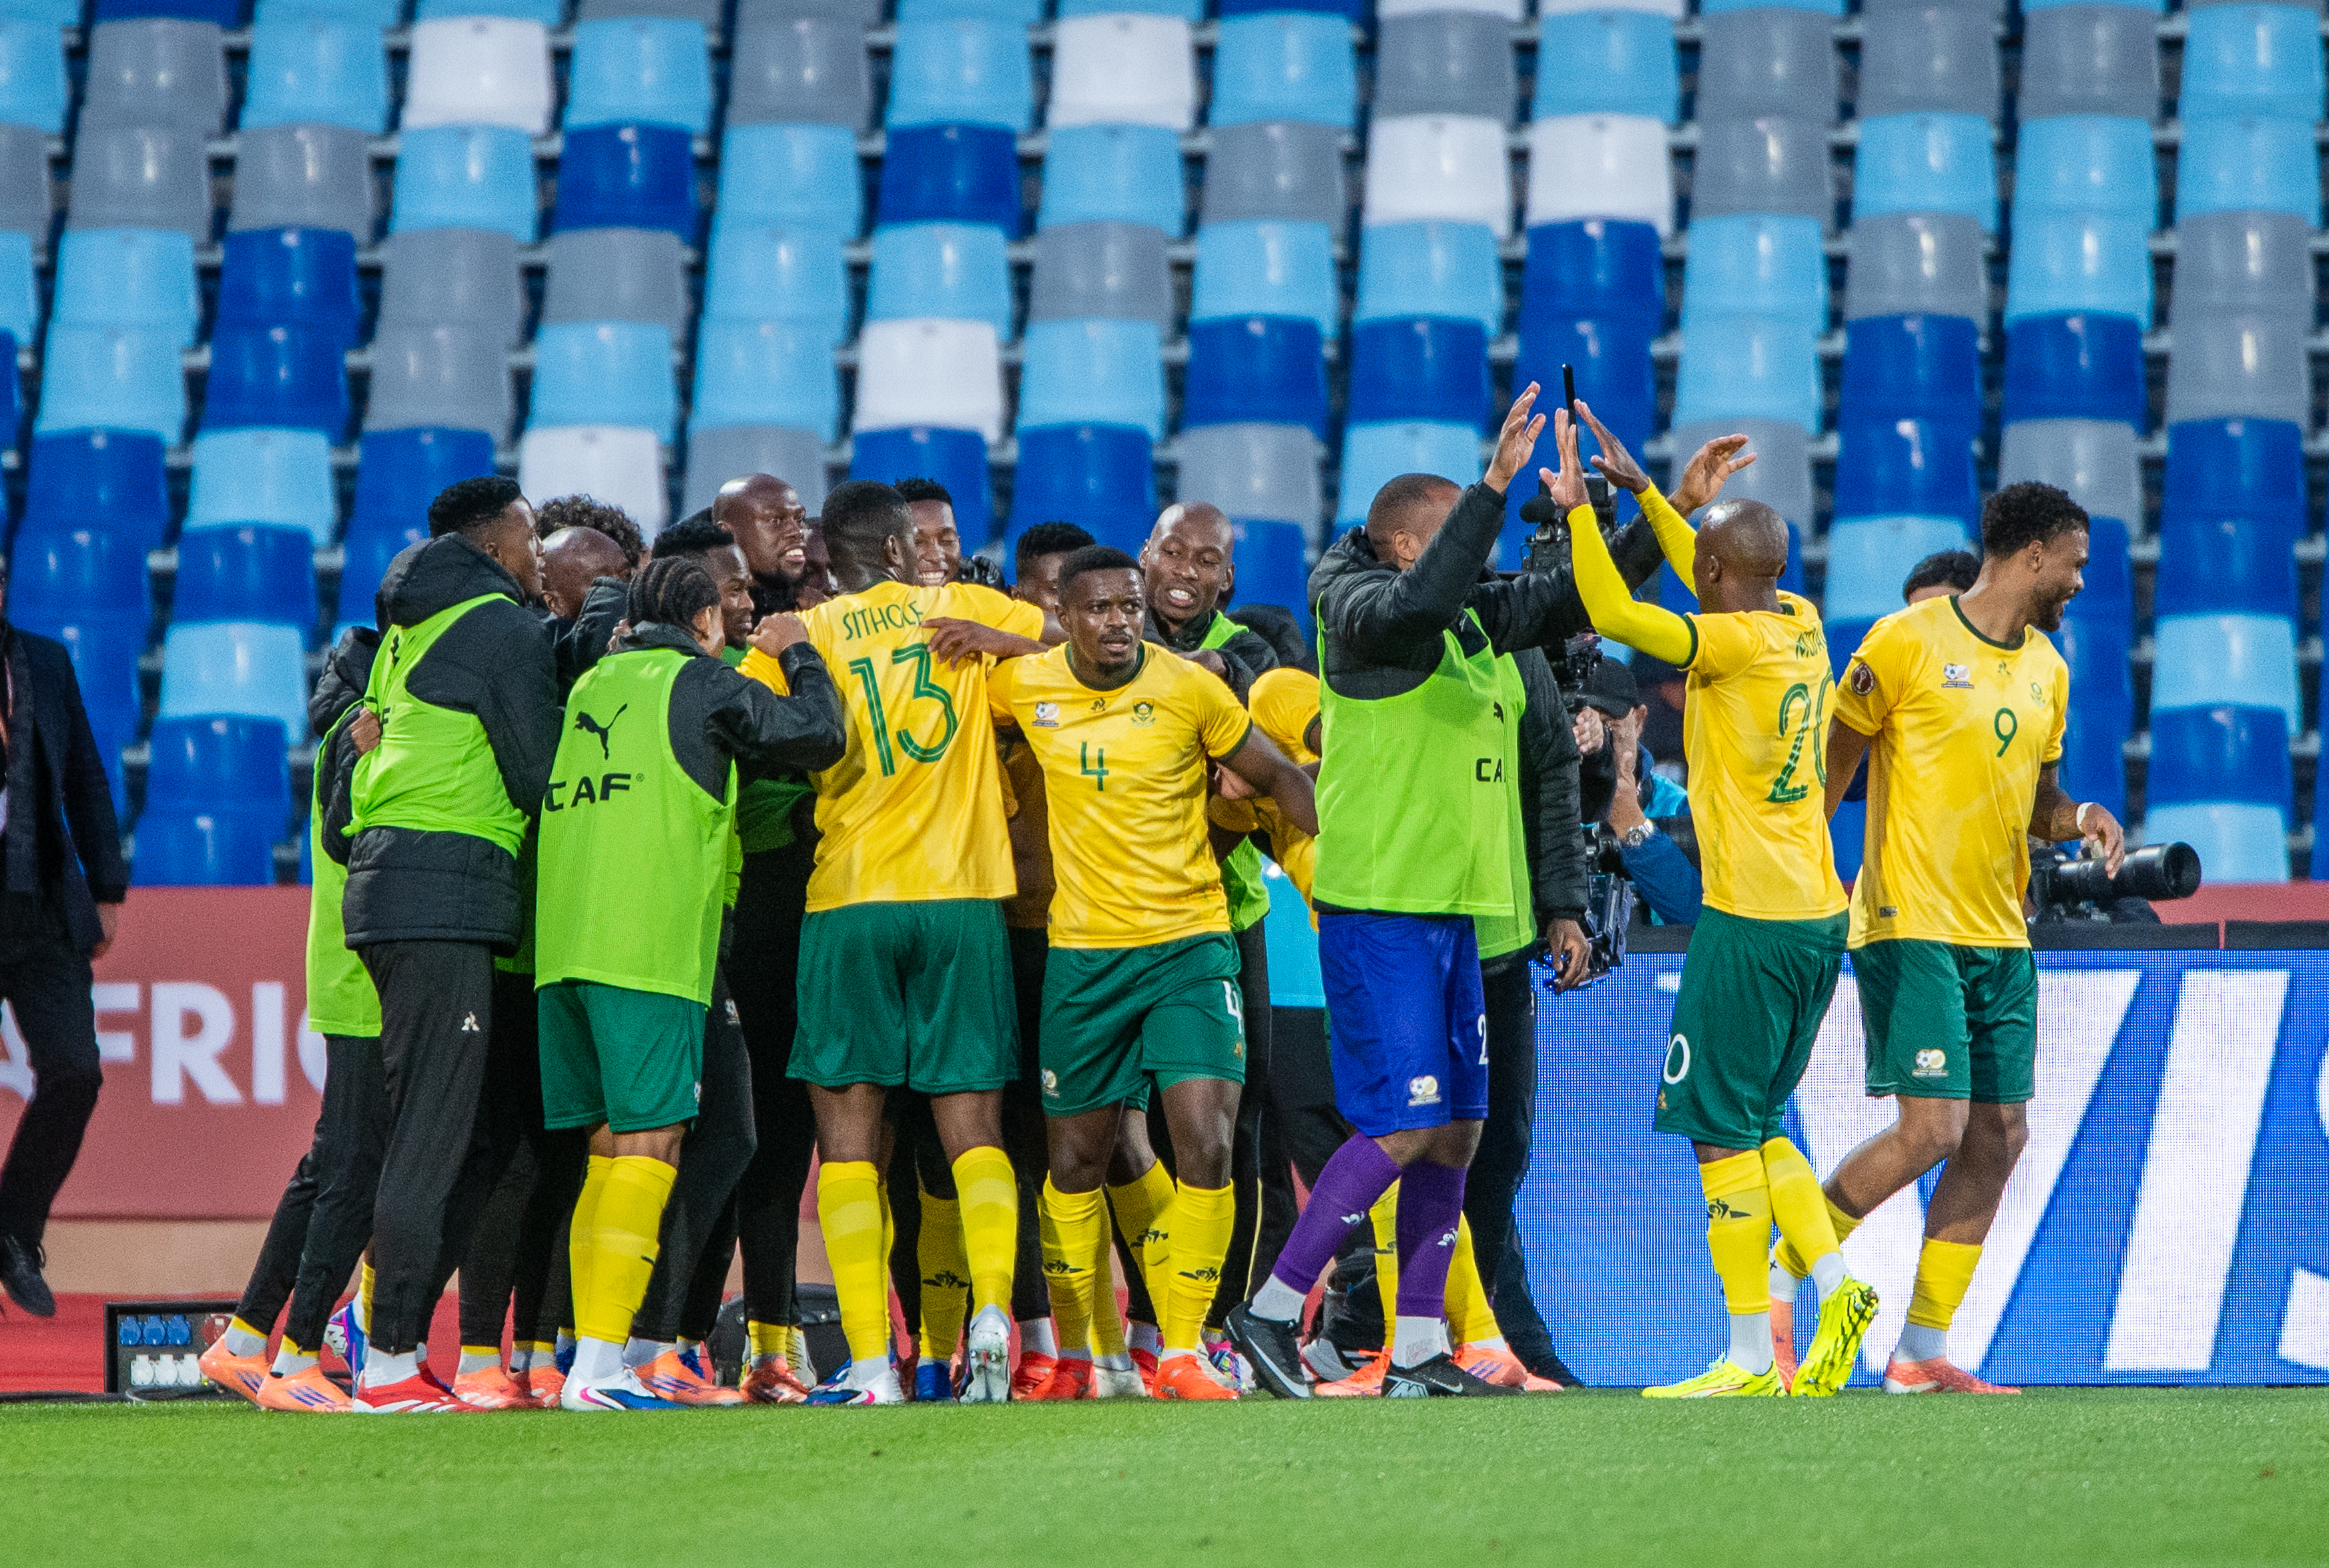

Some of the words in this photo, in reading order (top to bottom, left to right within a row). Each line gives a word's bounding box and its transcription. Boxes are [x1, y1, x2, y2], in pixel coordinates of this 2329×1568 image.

[848, 643, 958, 777] 13
[1993, 707, 2018, 758] 9
[1080, 741, 1109, 791] 4
[1475, 757, 1506, 783] CA
[1222, 980, 1242, 1034] 4
[1662, 1032, 1690, 1085] 0
